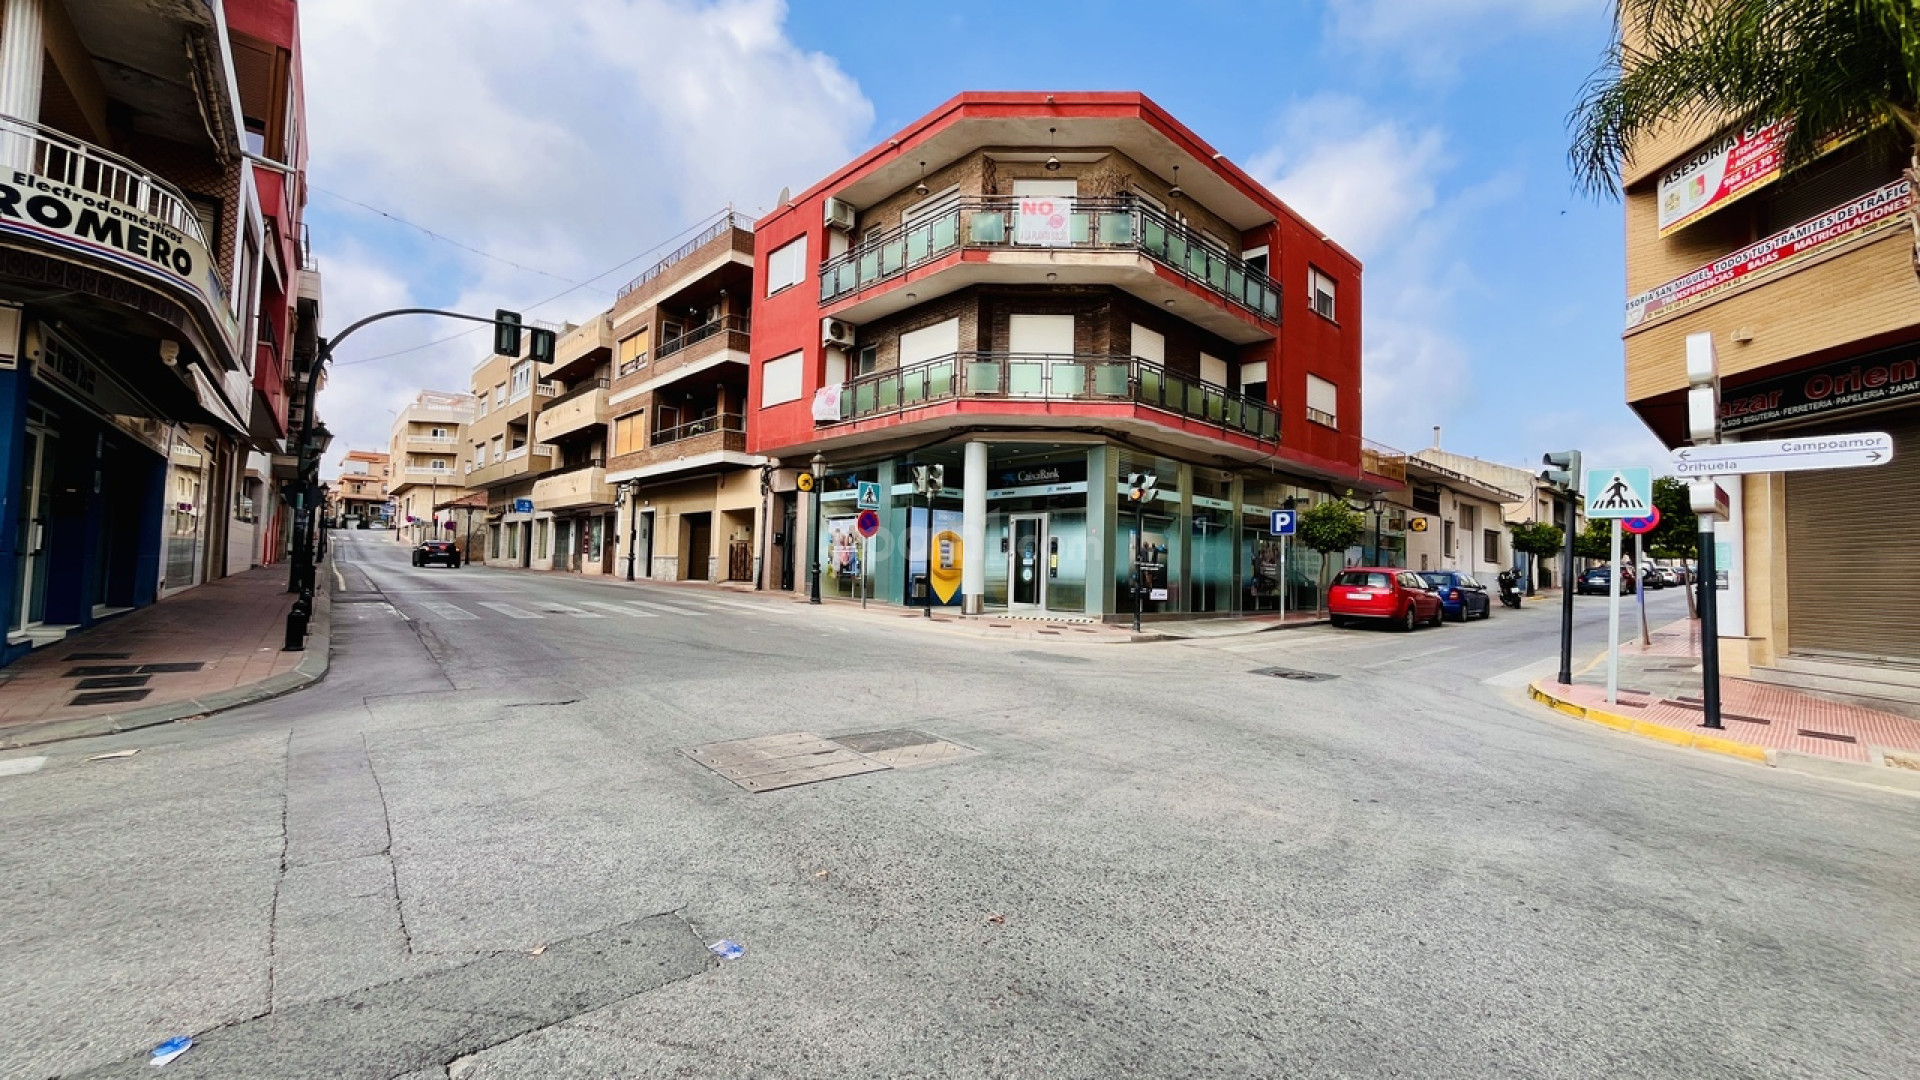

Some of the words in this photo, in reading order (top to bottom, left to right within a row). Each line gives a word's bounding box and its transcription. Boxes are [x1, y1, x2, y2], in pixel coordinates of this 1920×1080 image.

[1663, 135, 1737, 188] ASESORIA
[13, 170, 183, 245] Electrodomésticos
[1022, 201, 1054, 216] NO
[0, 183, 192, 277] ROMERO
[1715, 250, 1750, 273] TODOS
[1751, 242, 1772, 258] TUS
[1837, 204, 1858, 222] DE
[1747, 250, 1779, 271] BAJAS
[1793, 196, 1911, 253] MATRICULACIONES
[1720, 391, 1783, 419] azar
[1804, 357, 1920, 401] Orien
[1783, 399, 1833, 416] FERRETERIA
[1836, 388, 1885, 405] PAPELERIA
[1782, 437, 1882, 452] Campoamor
[1018, 467, 1060, 481] CaixaBank
[1677, 461, 1738, 472] Orihuela
[1275, 513, 1291, 532] P
